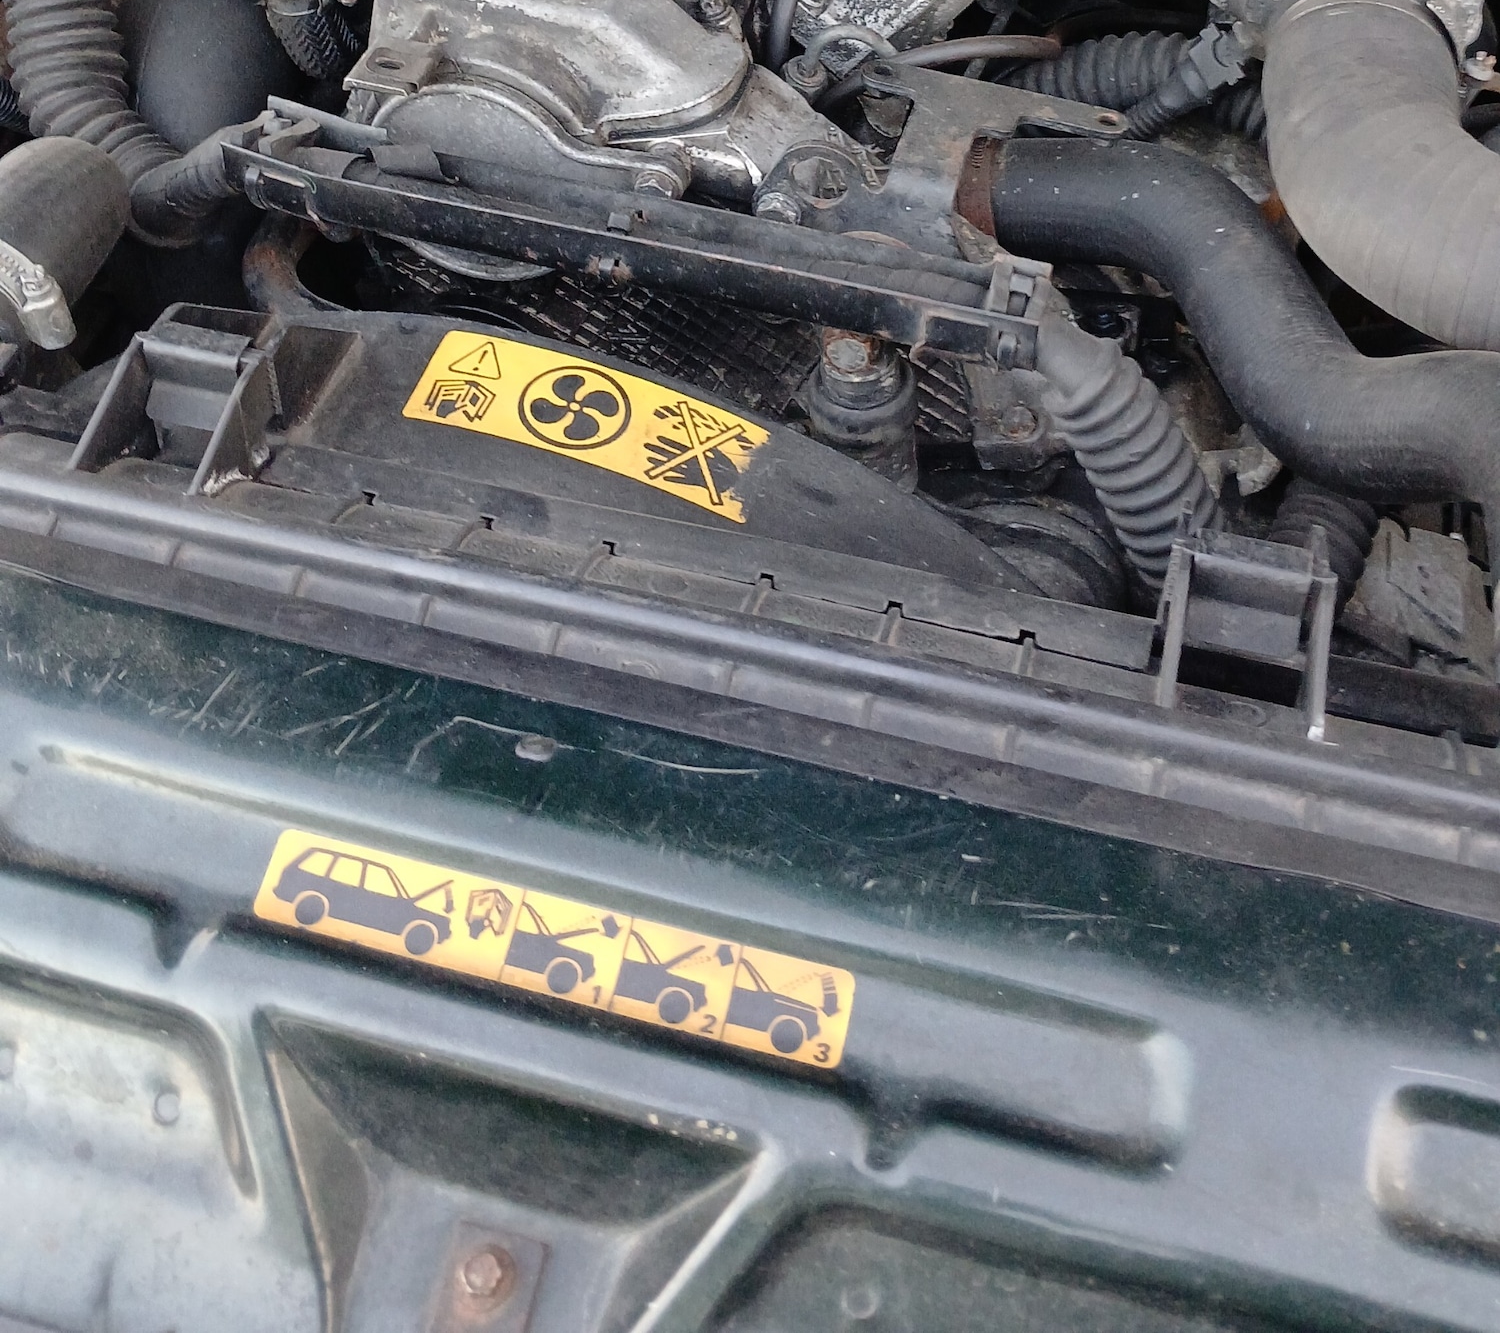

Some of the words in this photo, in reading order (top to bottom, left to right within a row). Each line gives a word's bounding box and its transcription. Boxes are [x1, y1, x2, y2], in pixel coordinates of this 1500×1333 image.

[593, 985, 601, 1004] 1
[700, 1014, 717, 1034] 2
[812, 1042, 831, 1063] 3
